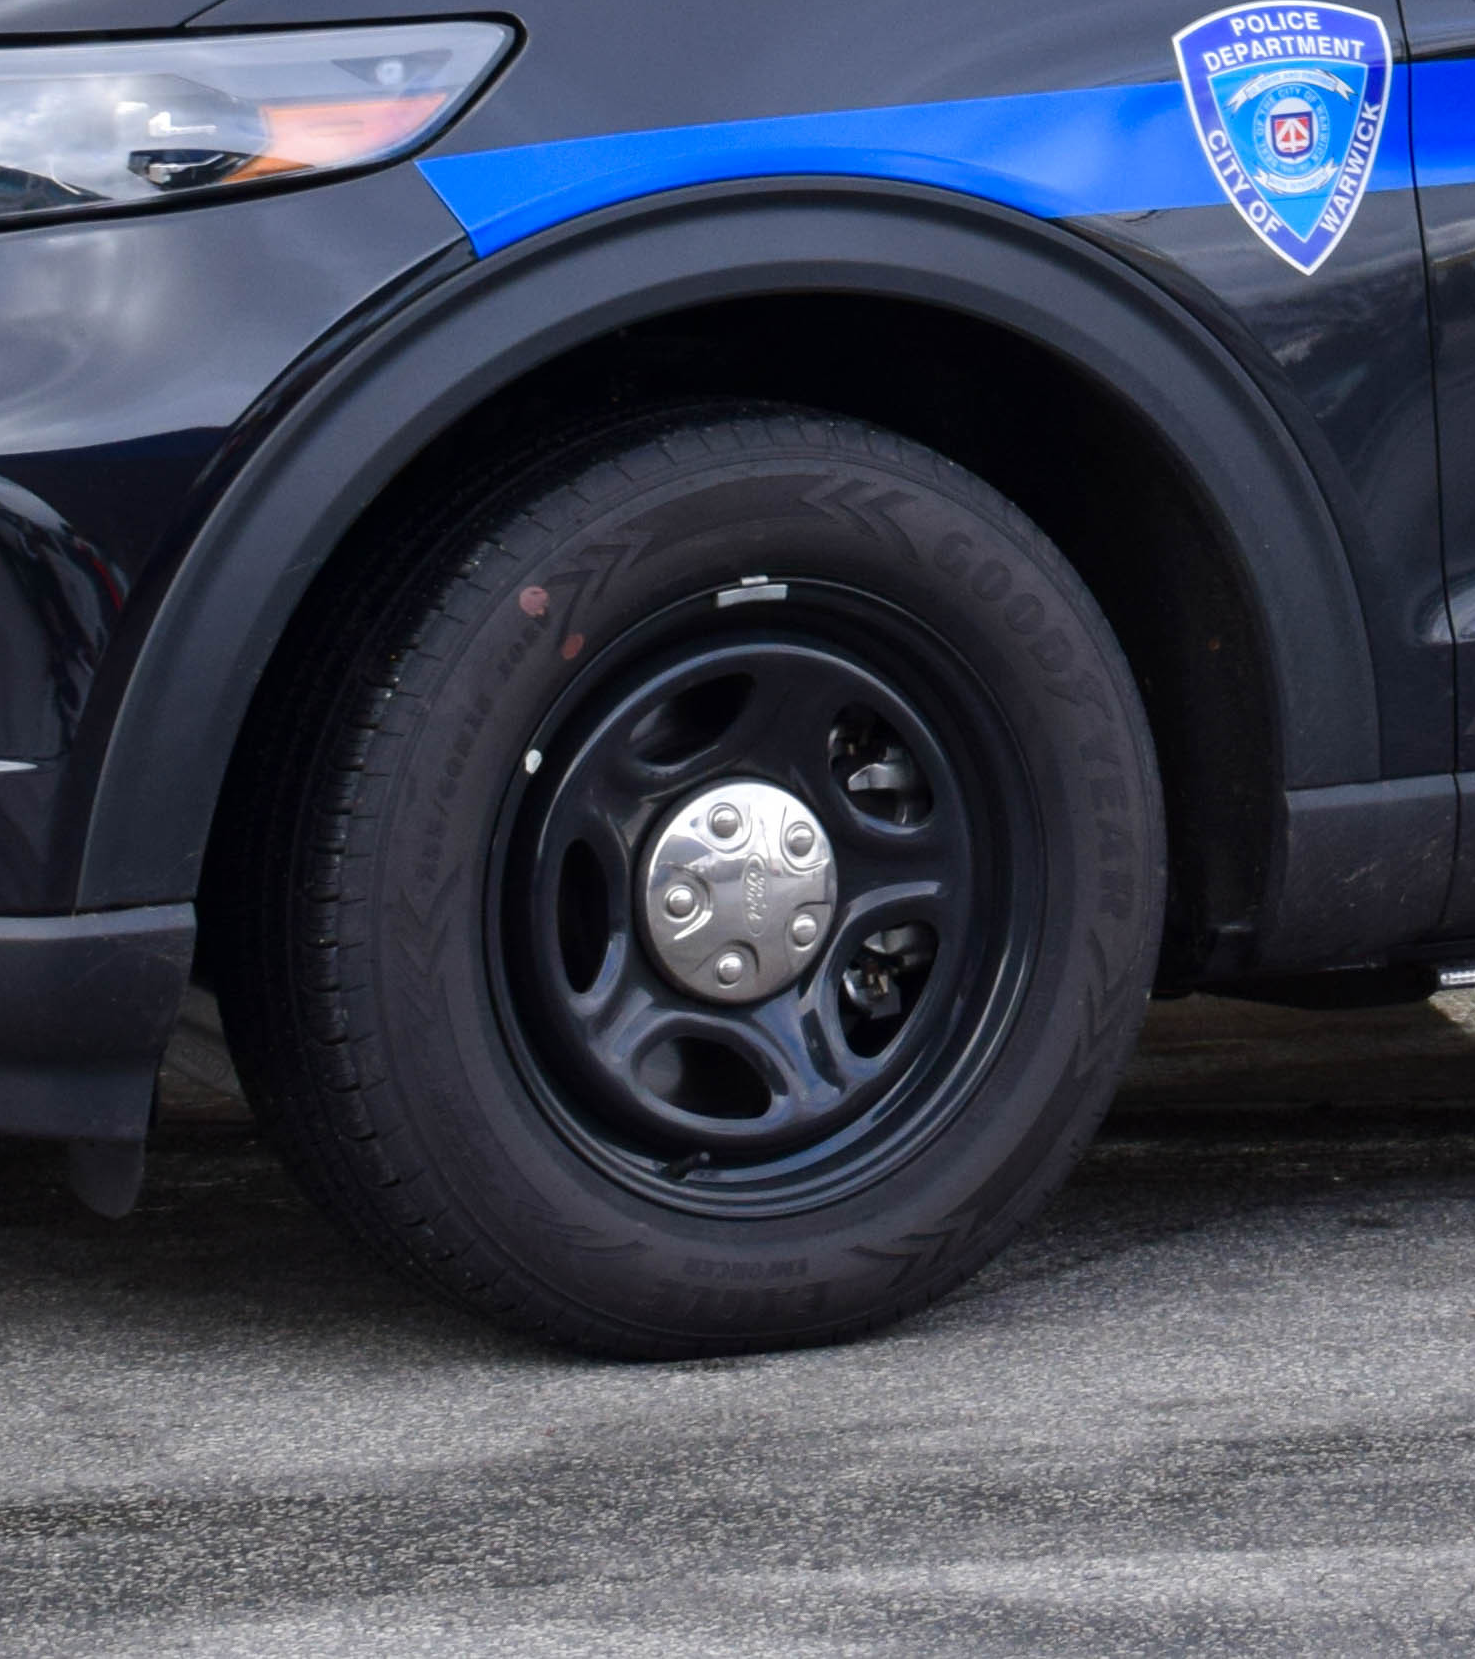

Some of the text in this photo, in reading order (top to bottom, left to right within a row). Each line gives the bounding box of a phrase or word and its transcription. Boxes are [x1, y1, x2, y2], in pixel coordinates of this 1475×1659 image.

[1229, 11, 1321, 37] POLICE
[1202, 35, 1365, 72] DEPARTMENT
[1208, 129, 1250, 196] CITY
[1248, 201, 1282, 234] OF
[1320, 102, 1381, 233] WARWICK
